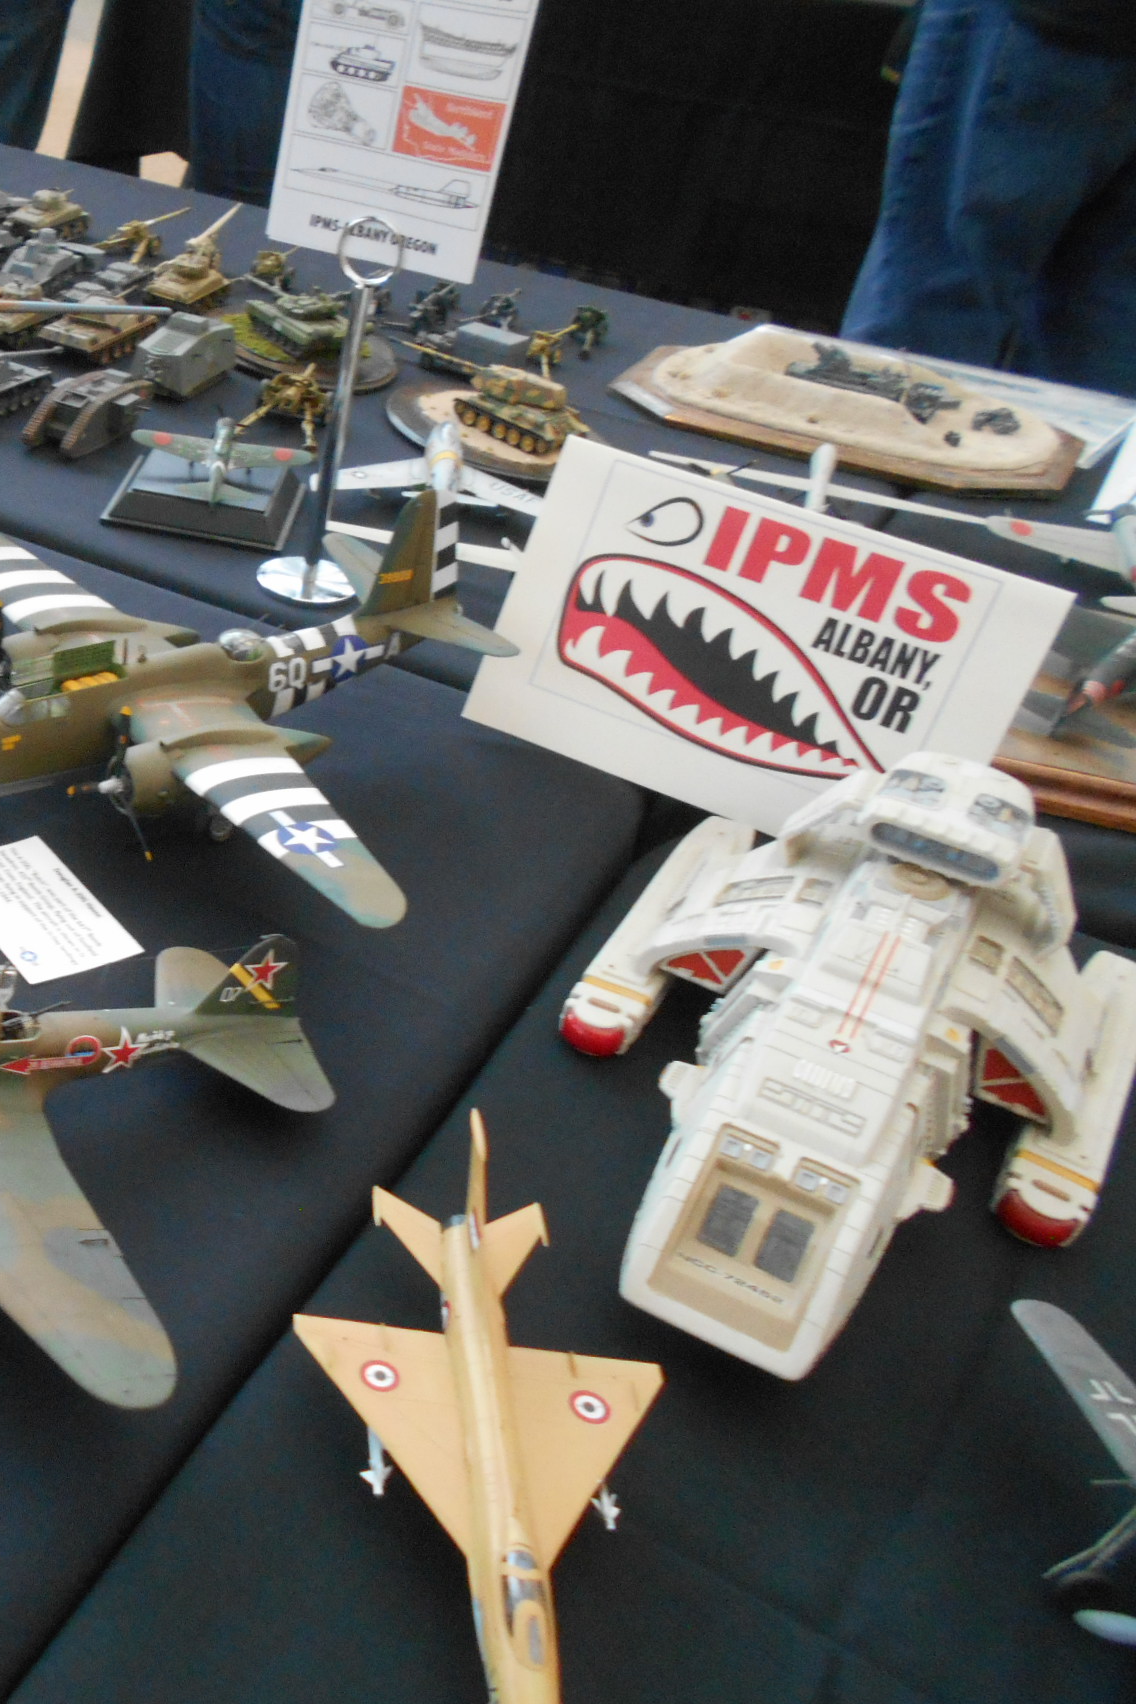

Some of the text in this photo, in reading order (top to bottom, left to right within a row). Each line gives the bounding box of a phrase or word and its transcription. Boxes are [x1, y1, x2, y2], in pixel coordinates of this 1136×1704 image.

[703, 505, 973, 643] IPMS
[812, 617, 941, 691] ALBANY,
[850, 676, 923, 734] OR
